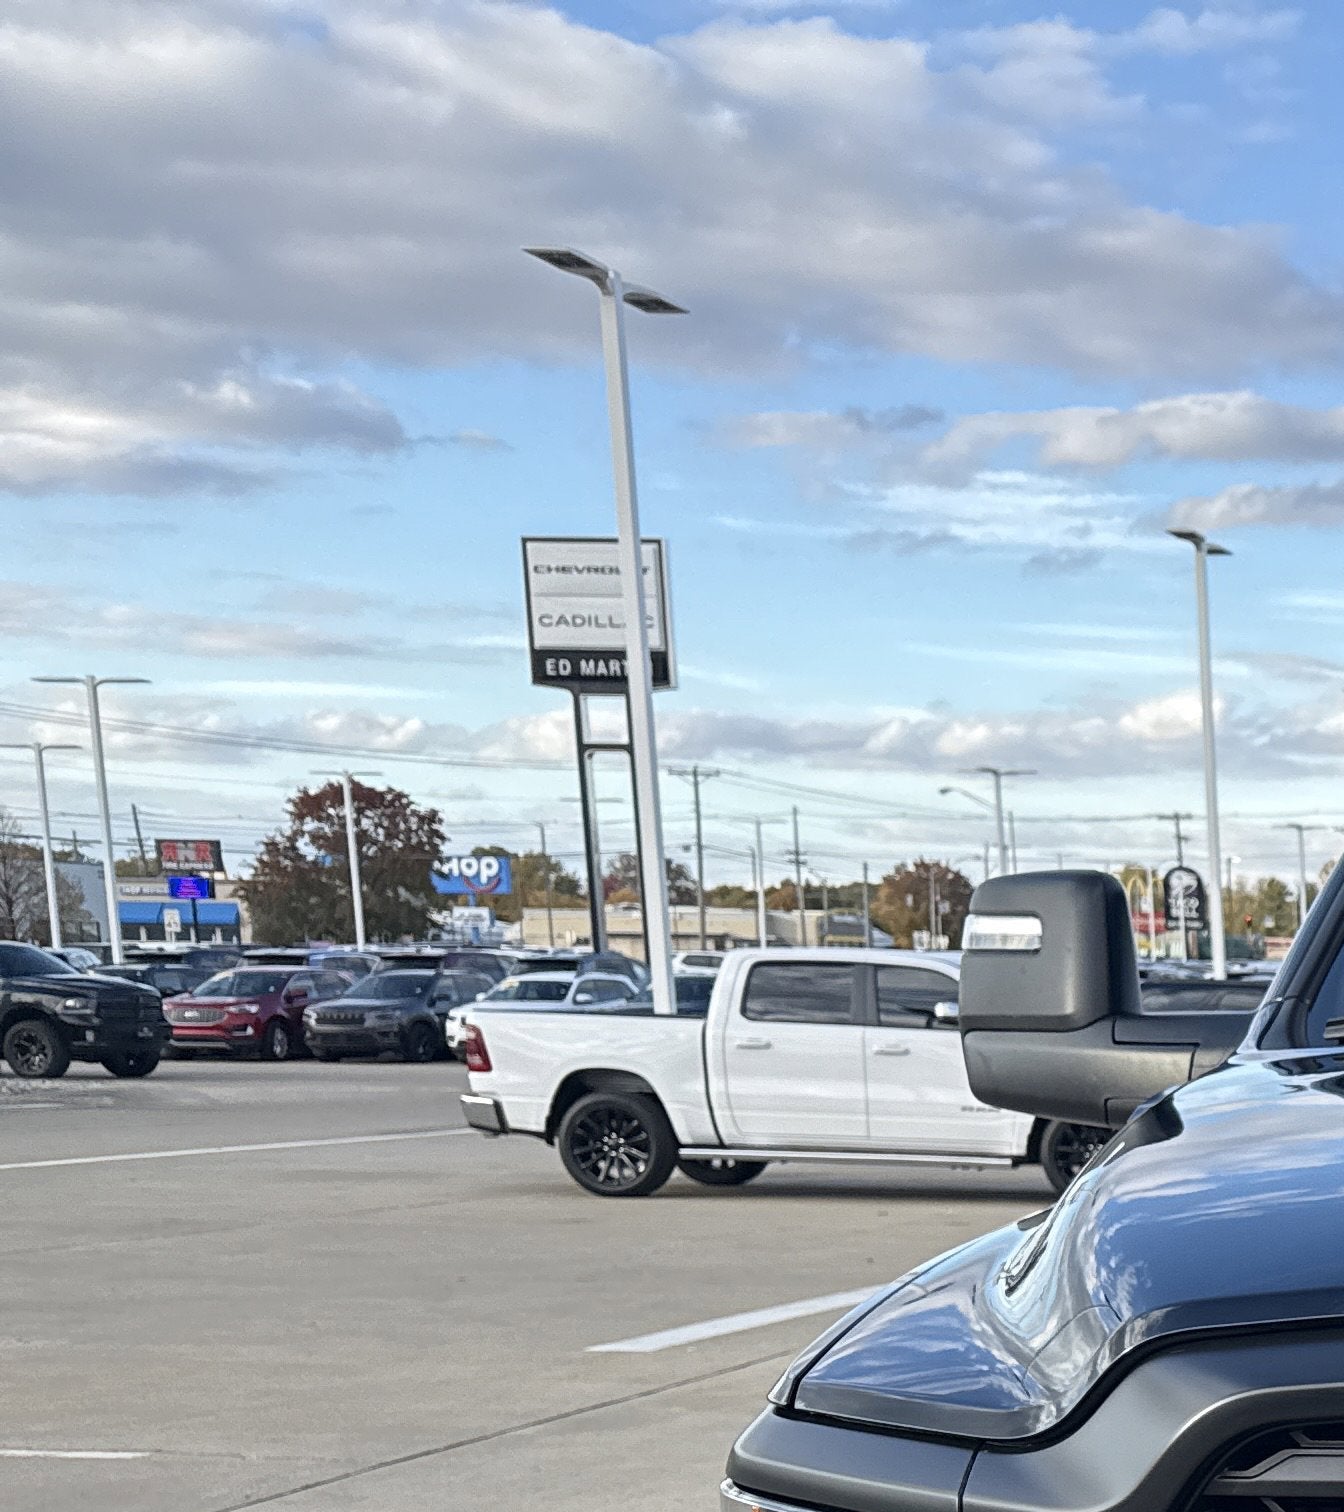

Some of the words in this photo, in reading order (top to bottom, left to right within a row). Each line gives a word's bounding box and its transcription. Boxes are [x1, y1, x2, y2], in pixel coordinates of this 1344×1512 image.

[533, 564, 650, 576] CHEVROLT
[538, 613, 655, 629] CADILLC
[546, 657, 572, 677] ED
